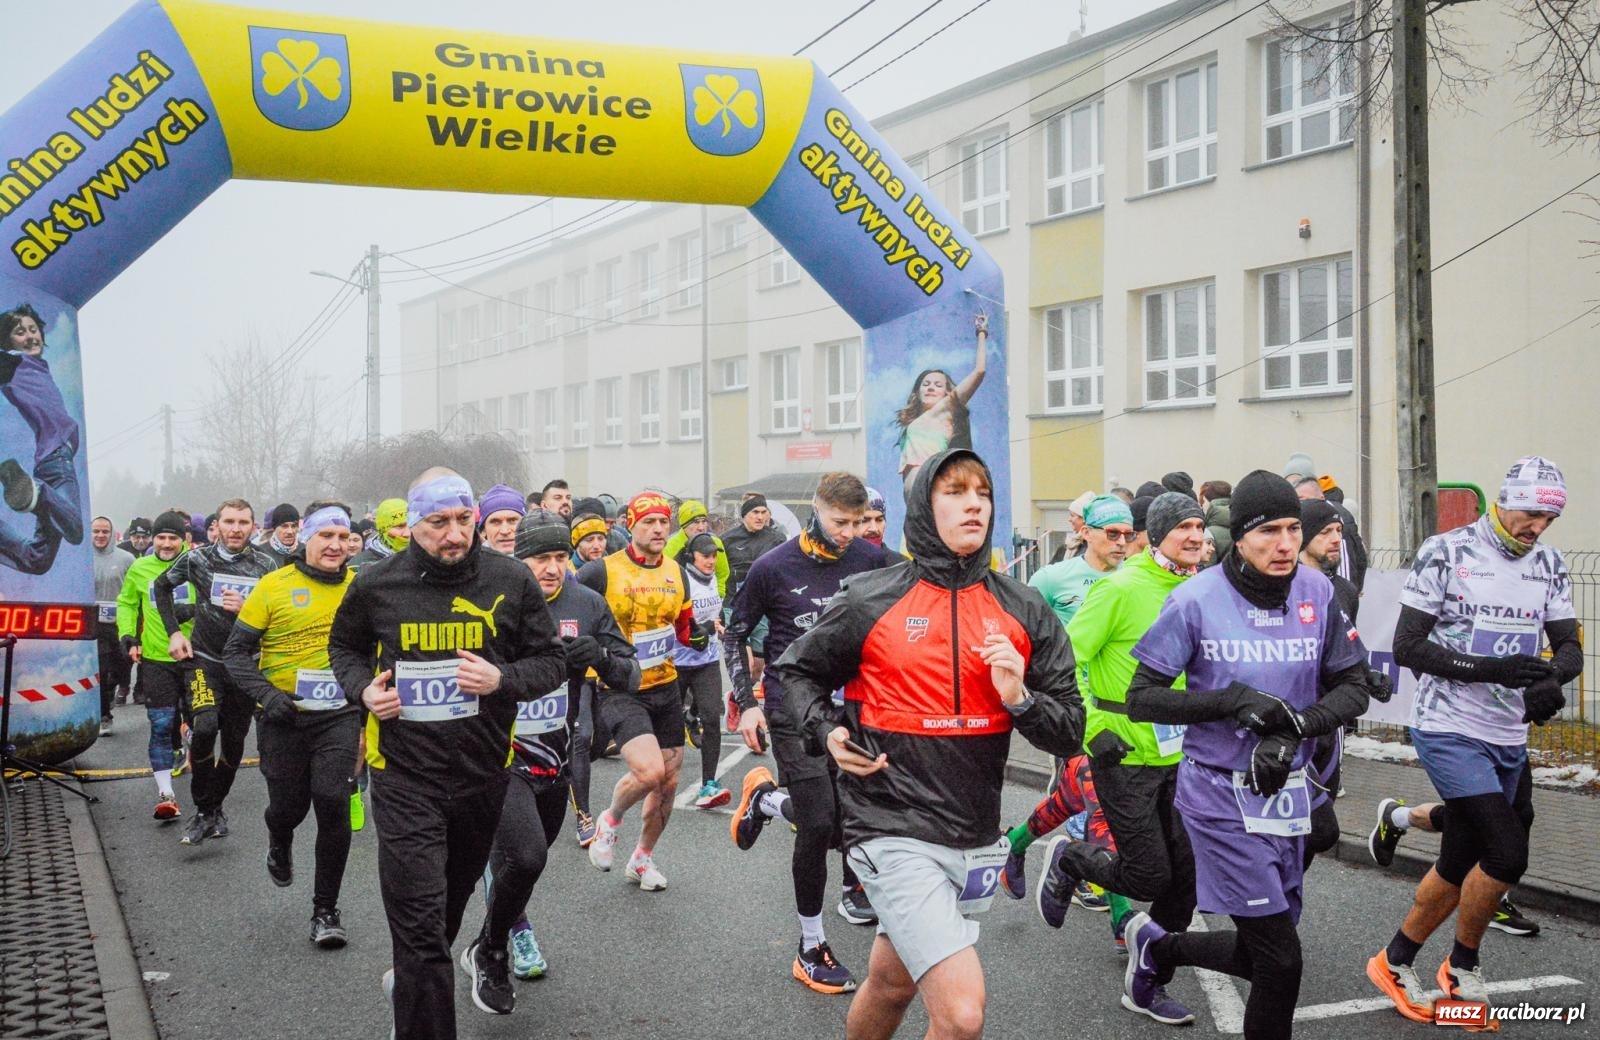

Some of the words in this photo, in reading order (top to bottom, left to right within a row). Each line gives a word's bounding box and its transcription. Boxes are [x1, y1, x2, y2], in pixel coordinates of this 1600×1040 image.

[435, 42, 605, 79] Gmina
[391, 70, 652, 119] Pietrowice
[0, 131, 85, 214] mina
[67, 49, 174, 140] ludzi
[426, 115, 617, 156] Wielkie
[11, 97, 209, 269] aktywnych
[824, 107, 906, 201] Gmina
[904, 193, 973, 270] ludzi
[799, 143, 944, 296] aktywnych
[692, 596, 723, 609] RUNNE
[400, 622, 483, 651] PUMA
[648, 638, 667, 657] 44
[1200, 637, 1318, 663] RUNNER
[1493, 634, 1521, 656] 66
[312, 682, 338, 699] 60
[410, 677, 465, 705] 102
[923, 718, 957, 728] BOXING
[981, 867, 1002, 897] 9
